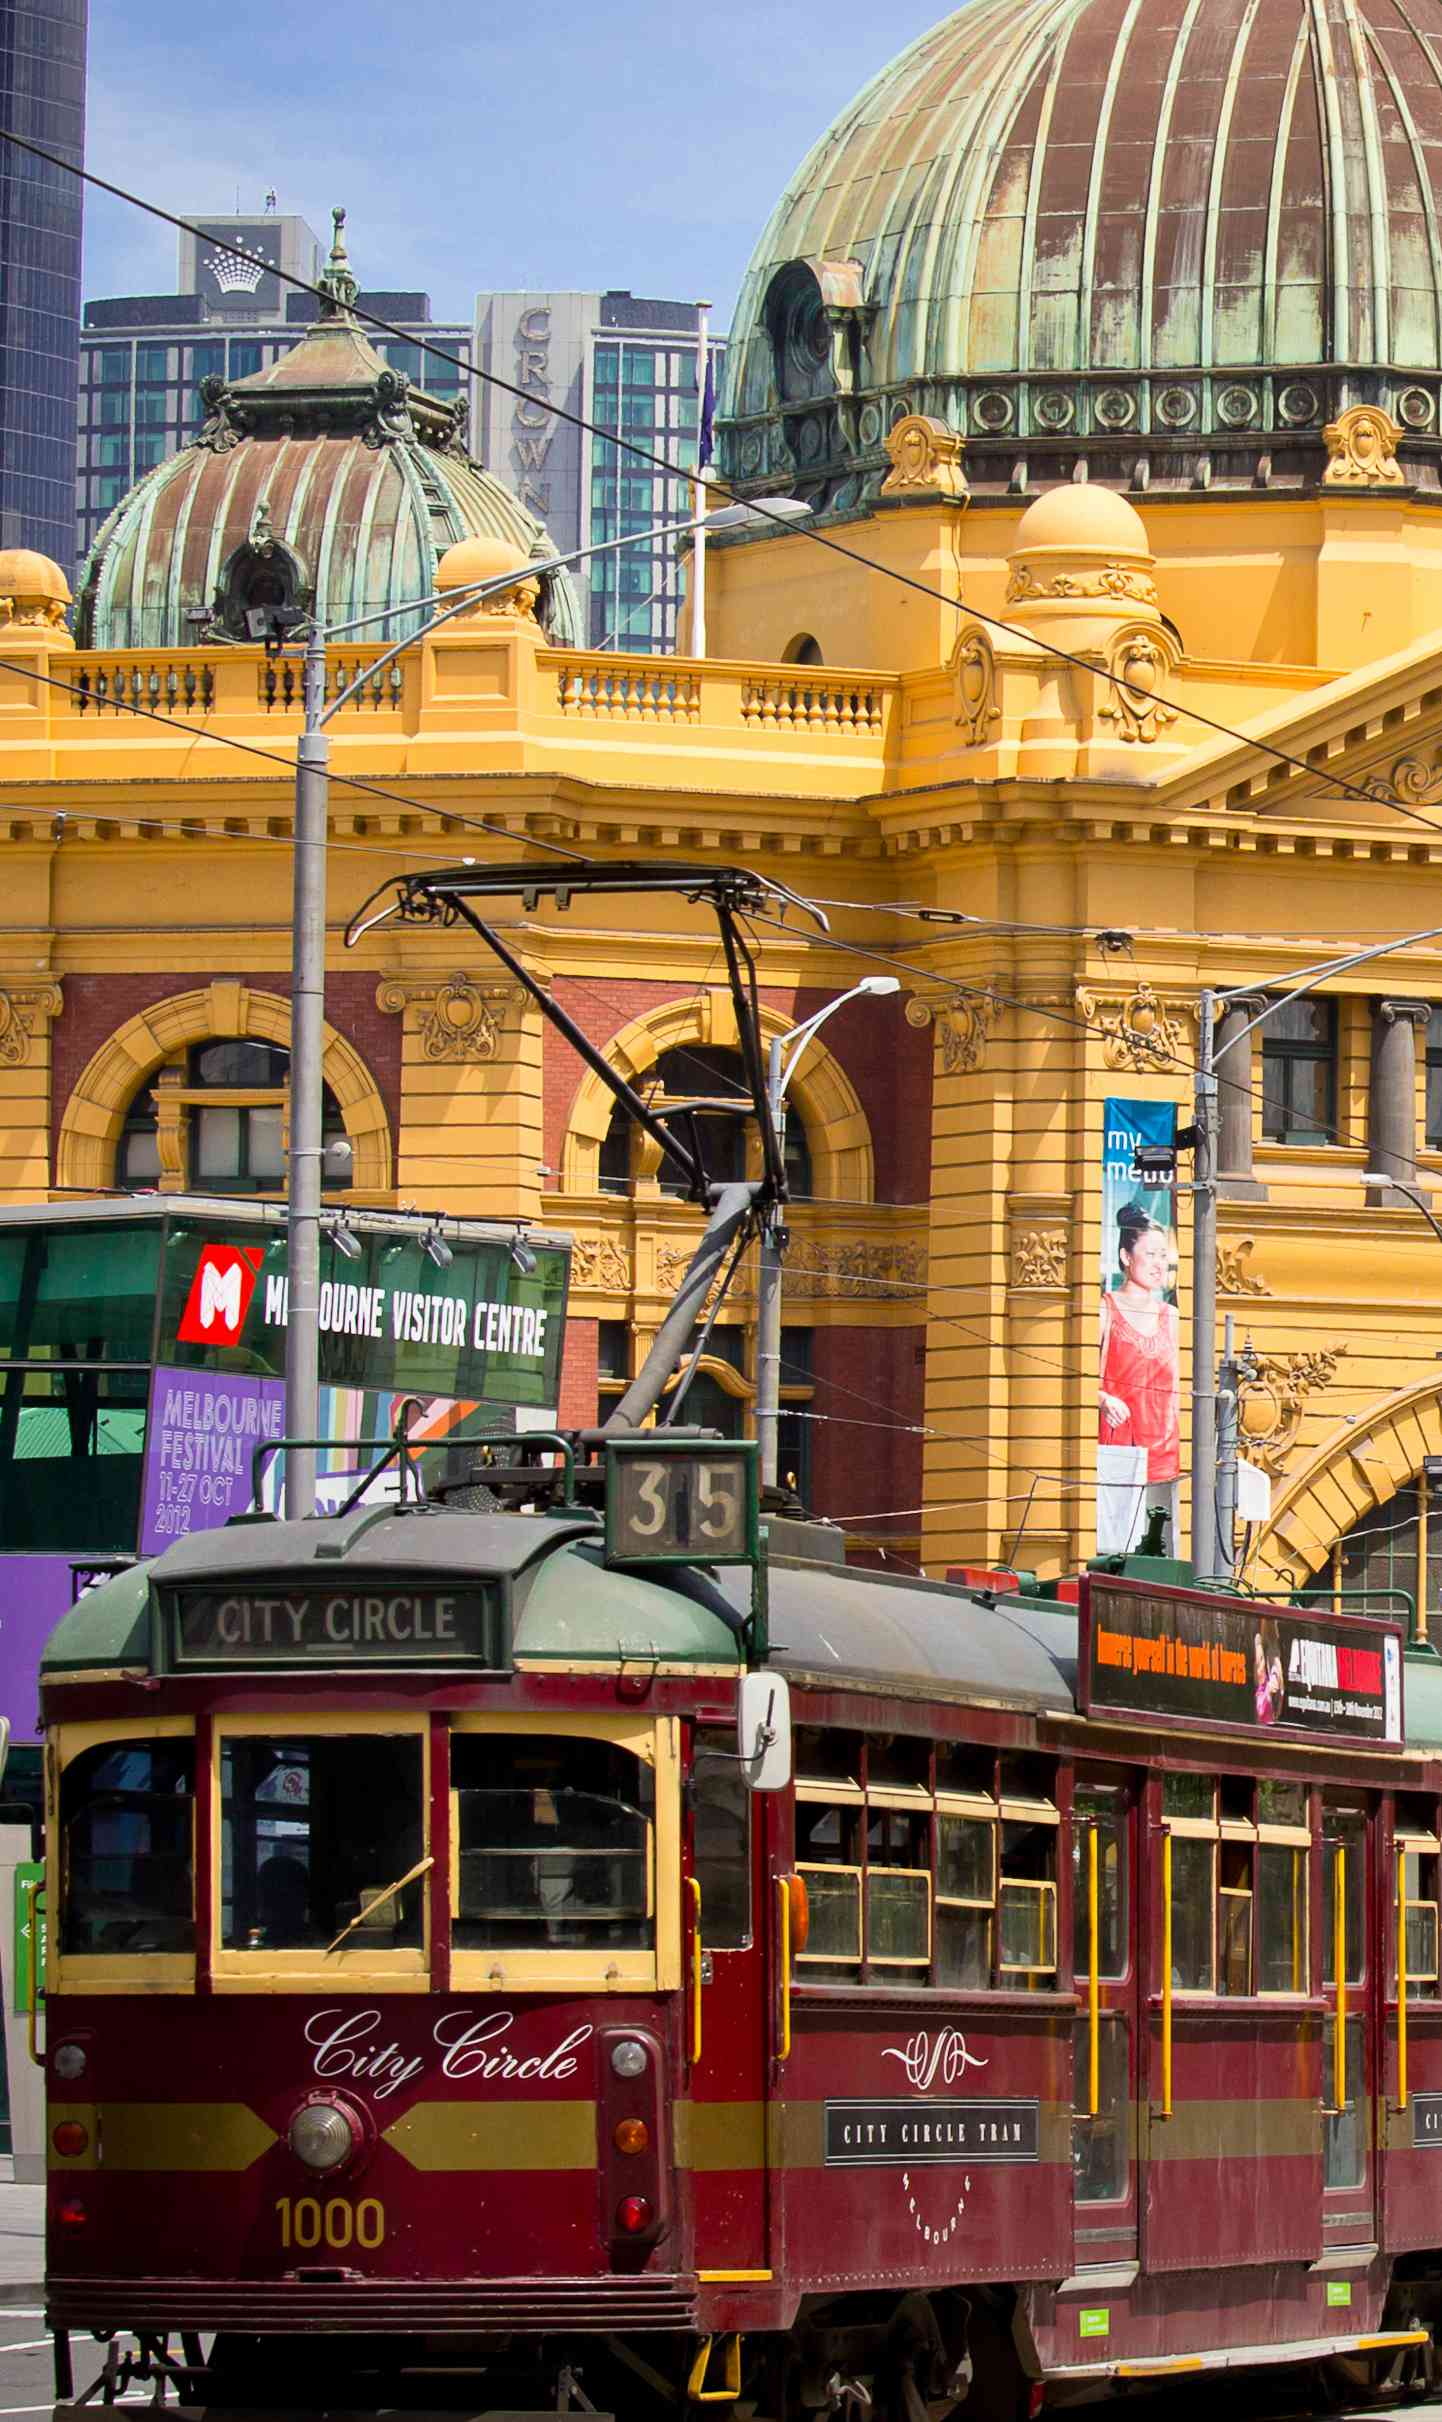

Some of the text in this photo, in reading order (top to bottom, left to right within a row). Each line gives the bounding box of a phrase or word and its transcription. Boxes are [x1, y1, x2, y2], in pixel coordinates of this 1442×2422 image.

[515, 307, 554, 514] CROWN
[1107, 1130, 1142, 1158] my
[265, 1275, 548, 1357] MOURNE VISITOR CENTRE
[163, 1389, 283, 1438] MELBOURNE
[160, 1430, 244, 1475] FESTIVAL
[159, 1471, 234, 1507] 11-27 OCT
[629, 1460, 738, 1538] 35
[154, 1503, 192, 1536] 2012
[217, 1598, 457, 1643] CITY CIRCLE
[304, 2008, 594, 2100] City Circle
[843, 2122, 1021, 2145] CITY CIRCLE TRAM
[1425, 2112, 1442, 2130] CI
[275, 2197, 385, 2249] 1000
